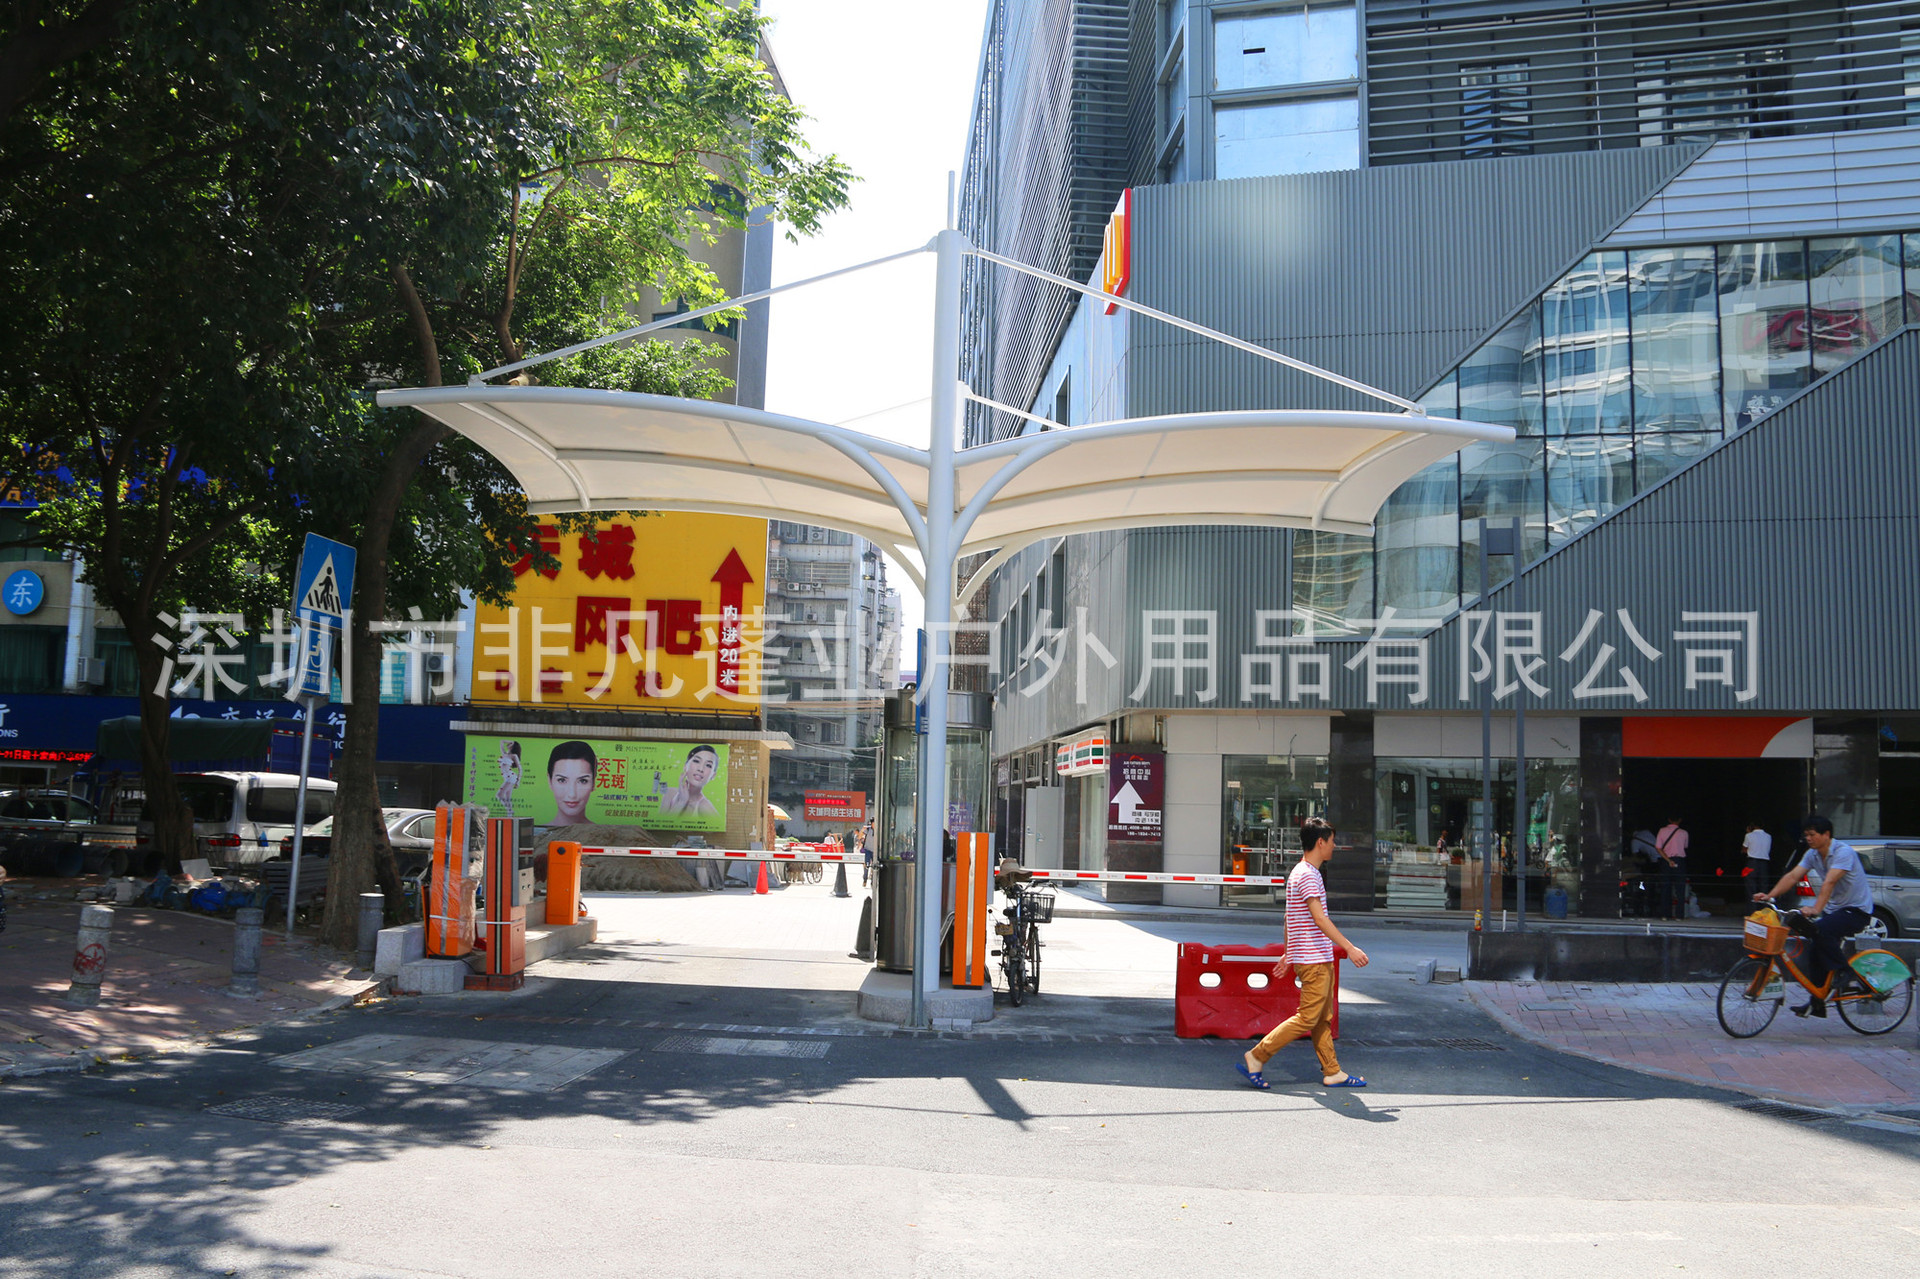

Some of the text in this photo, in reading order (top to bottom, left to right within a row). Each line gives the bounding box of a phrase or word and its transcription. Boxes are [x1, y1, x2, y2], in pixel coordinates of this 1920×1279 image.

[10, 577, 33, 608] 东
[574, 596, 702, 655] 网吧
[719, 604, 739, 686] 内进20米
[597, 757, 626, 773] 天下
[596, 774, 626, 789] 无斑
[808, 807, 861, 818] 天城网络生活馆
